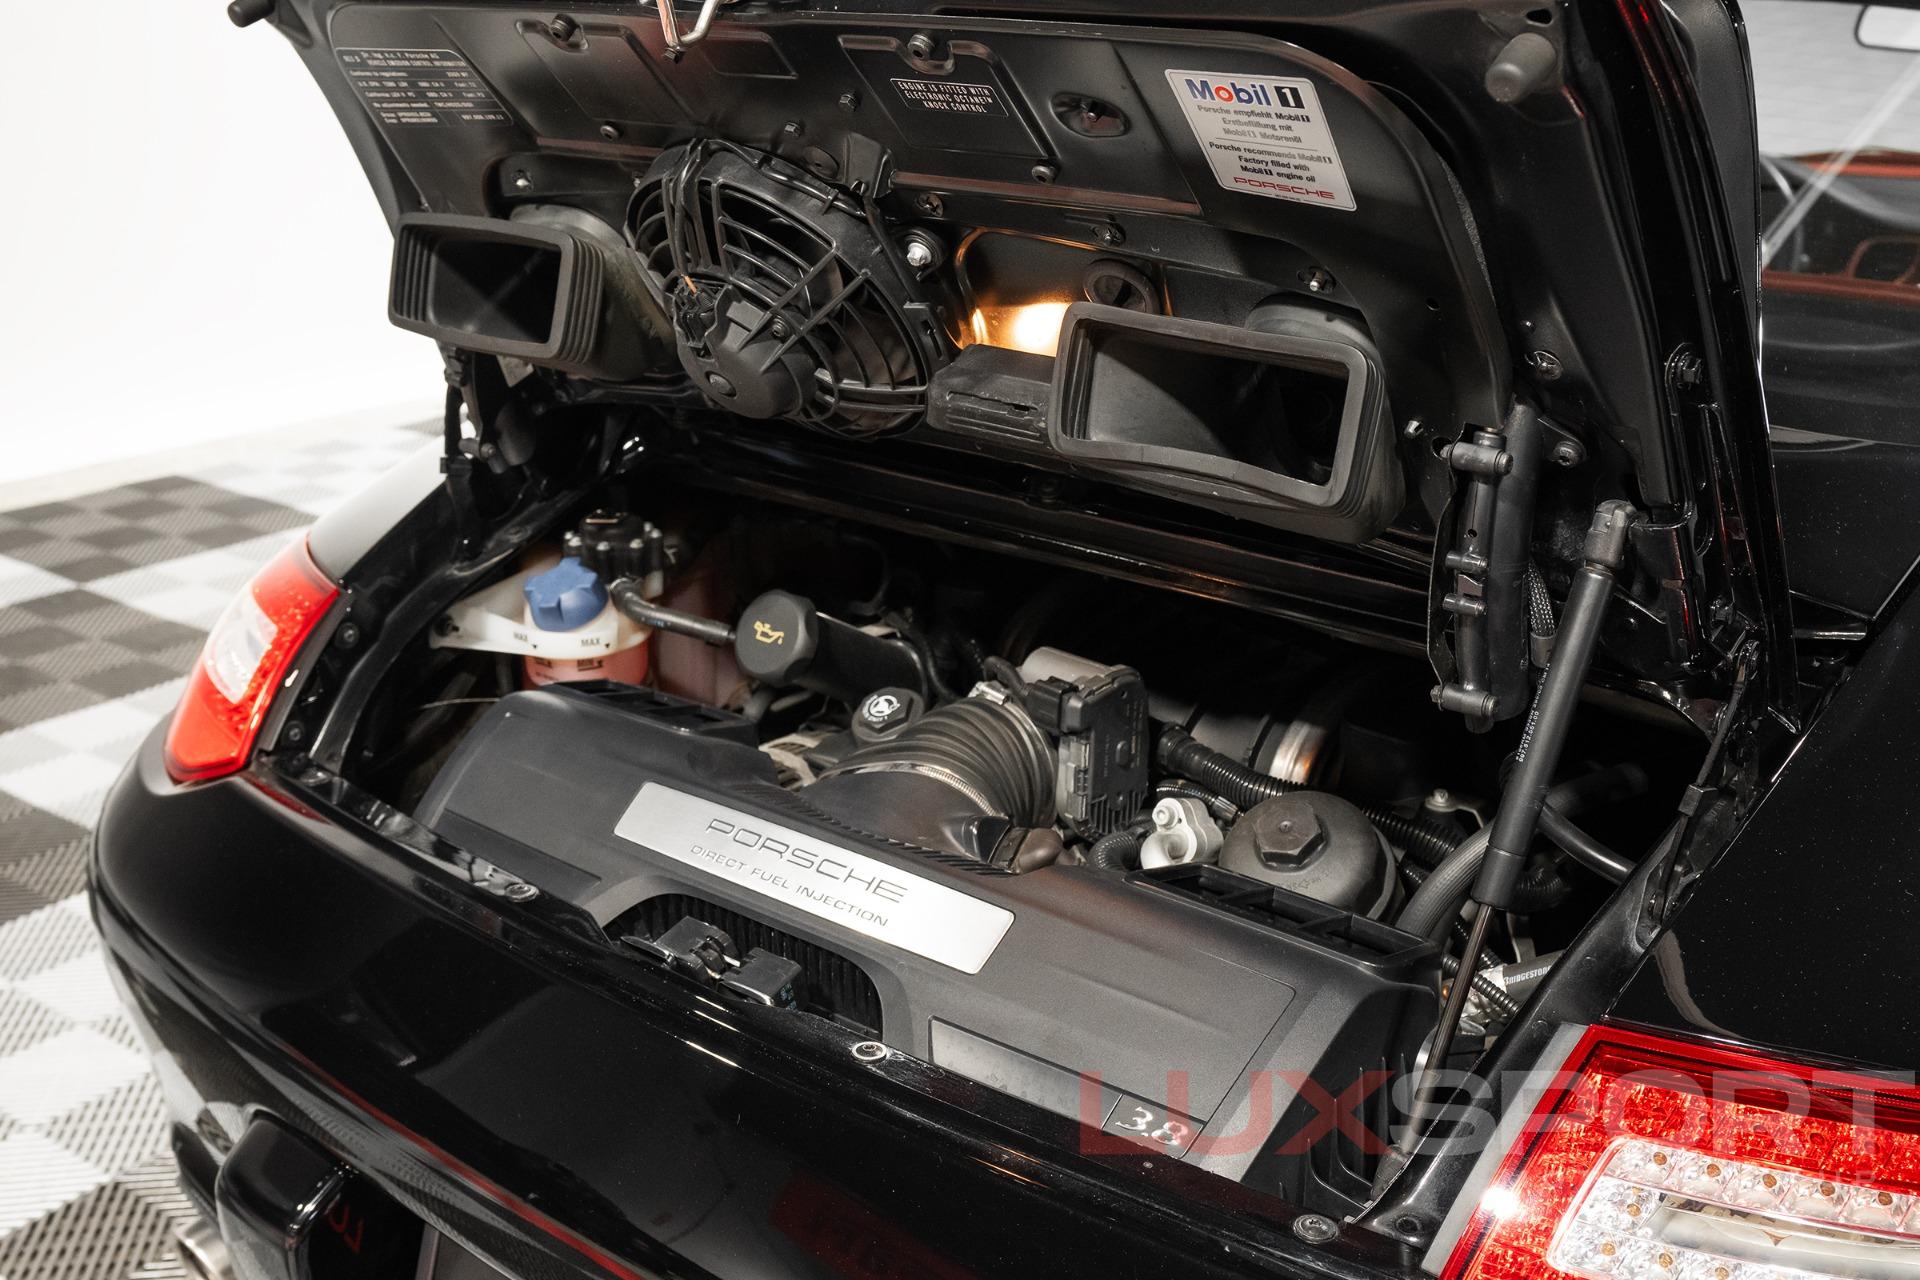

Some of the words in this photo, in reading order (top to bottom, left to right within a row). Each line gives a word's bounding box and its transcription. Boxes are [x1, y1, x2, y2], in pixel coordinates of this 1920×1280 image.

[897, 82, 927, 91] ENGINE
[928, 84, 938, 92] IS
[939, 85, 967, 94] FITTED
[969, 87, 991, 96] WITH
[904, 91, 952, 102] ELECTRONIC
[1185, 78, 1272, 106] Mobil
[923, 101, 949, 109] KNOCK
[950, 102, 987, 113] CONTROL
[1197, 105, 1231, 115] Porsche
[1233, 109, 1272, 118] empfiehlt
[1279, 124, 1293, 132] mit
[1208, 141, 1241, 152] Porsche
[1243, 147, 1297, 159] recommends
[1238, 155, 1269, 167] Factory
[1271, 159, 1291, 169] filled
[1293, 163, 1310, 172] with
[1276, 170, 1303, 181] engine
[1305, 175, 1316, 183] oil
[1233, 176, 1335, 200] PORSCHE
[580, 638, 601, 647] MAX
[705, 818, 909, 904] PORSCHE
[690, 844, 748, 871] DIRECT
[751, 867, 791, 890] FUEL
[795, 884, 889, 927] INJECTION
[1115, 1105, 1189, 1147] 3.8
